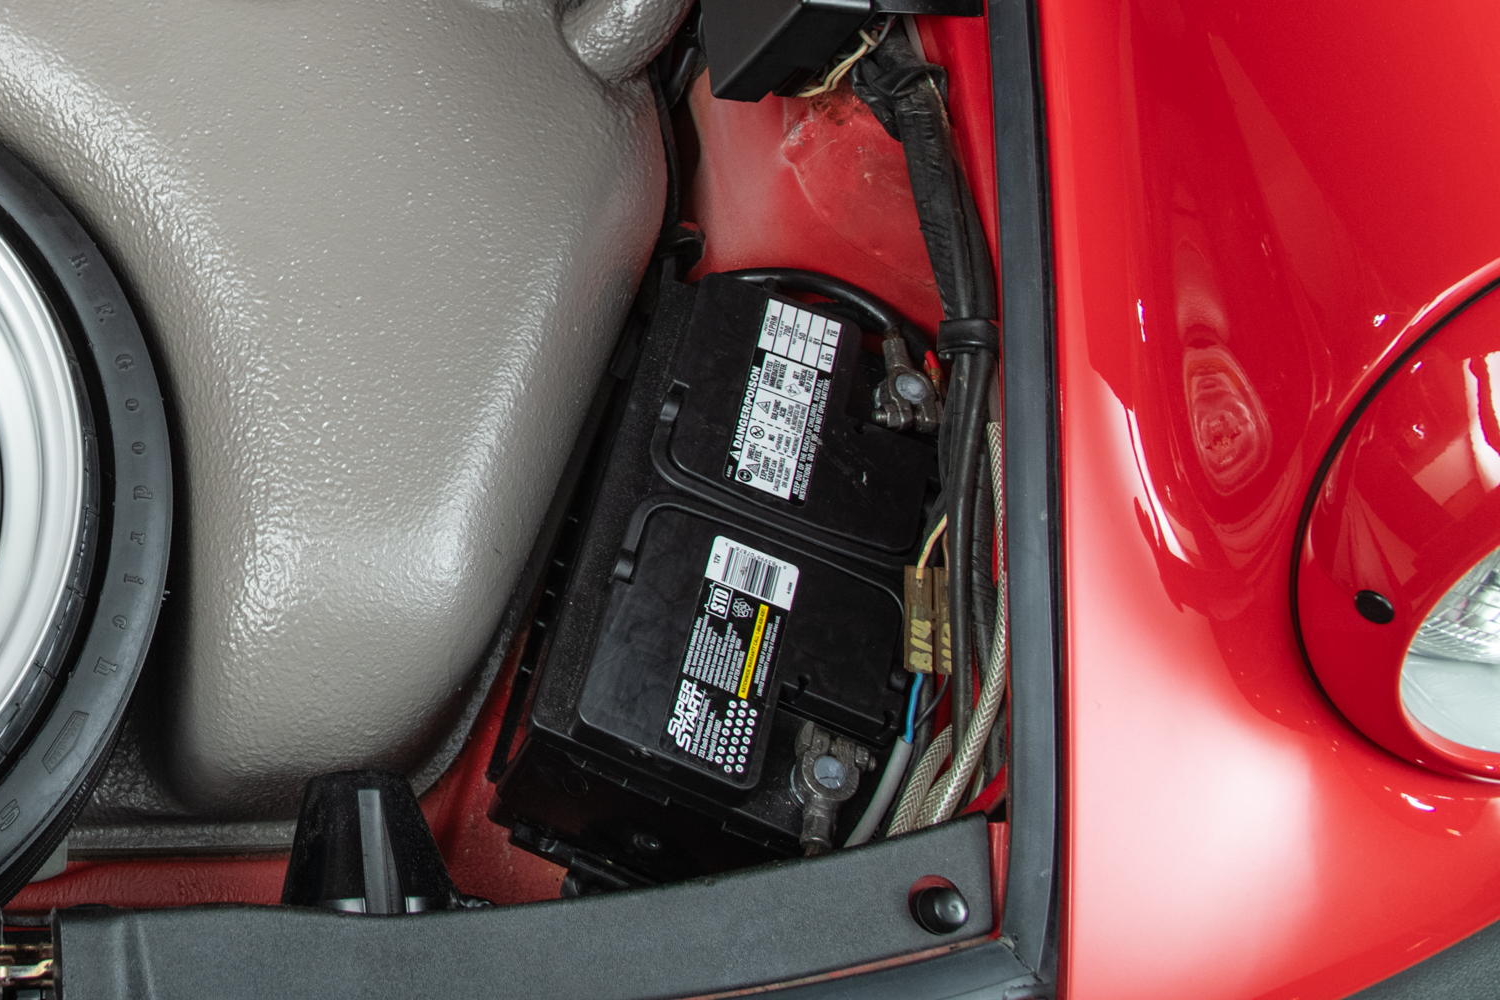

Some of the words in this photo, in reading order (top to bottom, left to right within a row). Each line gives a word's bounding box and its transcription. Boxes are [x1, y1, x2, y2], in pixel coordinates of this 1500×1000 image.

[767, 315, 778, 336] 91PRM
[782, 324, 792, 337] 700
[797, 331, 806, 340] 50
[830, 329, 838, 338] T6
[812, 337, 820, 345] 91
[824, 352, 832, 365] LB3
[765, 360, 773, 371] EYES
[762, 371, 770, 385] FLUSH
[768, 359, 780, 387] IMMEDIATELY
[798, 367, 807, 387] MEDICAL
[806, 369, 814, 382] FAST.
[775, 378, 783, 390] WITH
[804, 381, 812, 393] HELP
[813, 387, 821, 401] READ
[733, 365, 761, 449] DANGER/POISON
[778, 406, 786, 417] ACID
[807, 401, 818, 428] CHILDREN.
[815, 413, 823, 424] NOT
[806, 427, 812, 435] OF
[813, 424, 820, 432] DO
[767, 433, 774, 441] NO
[802, 434, 810, 452] REACH
[746, 443, 756, 460] SHIELD
[808, 442, 816, 453] NOT
[753, 448, 762, 462] EYES.
[799, 451, 807, 462] THE
[807, 452, 814, 461] DO
[759, 455, 770, 480] EXPLOSIVE
[797, 461, 804, 470] OF
[766, 467, 775, 482] GASES
[795, 469, 803, 481] OUT
[798, 461, 812, 500] INSTRUCTIONS.
[792, 480, 800, 495] KEEP
[92, 350, 154, 680] Goodrich
[713, 553, 721, 564] 12V
[710, 587, 729, 614] STD
[747, 645, 755, 668] WARRANTY
[666, 677, 693, 738] SUPER
[674, 681, 704, 752] START
